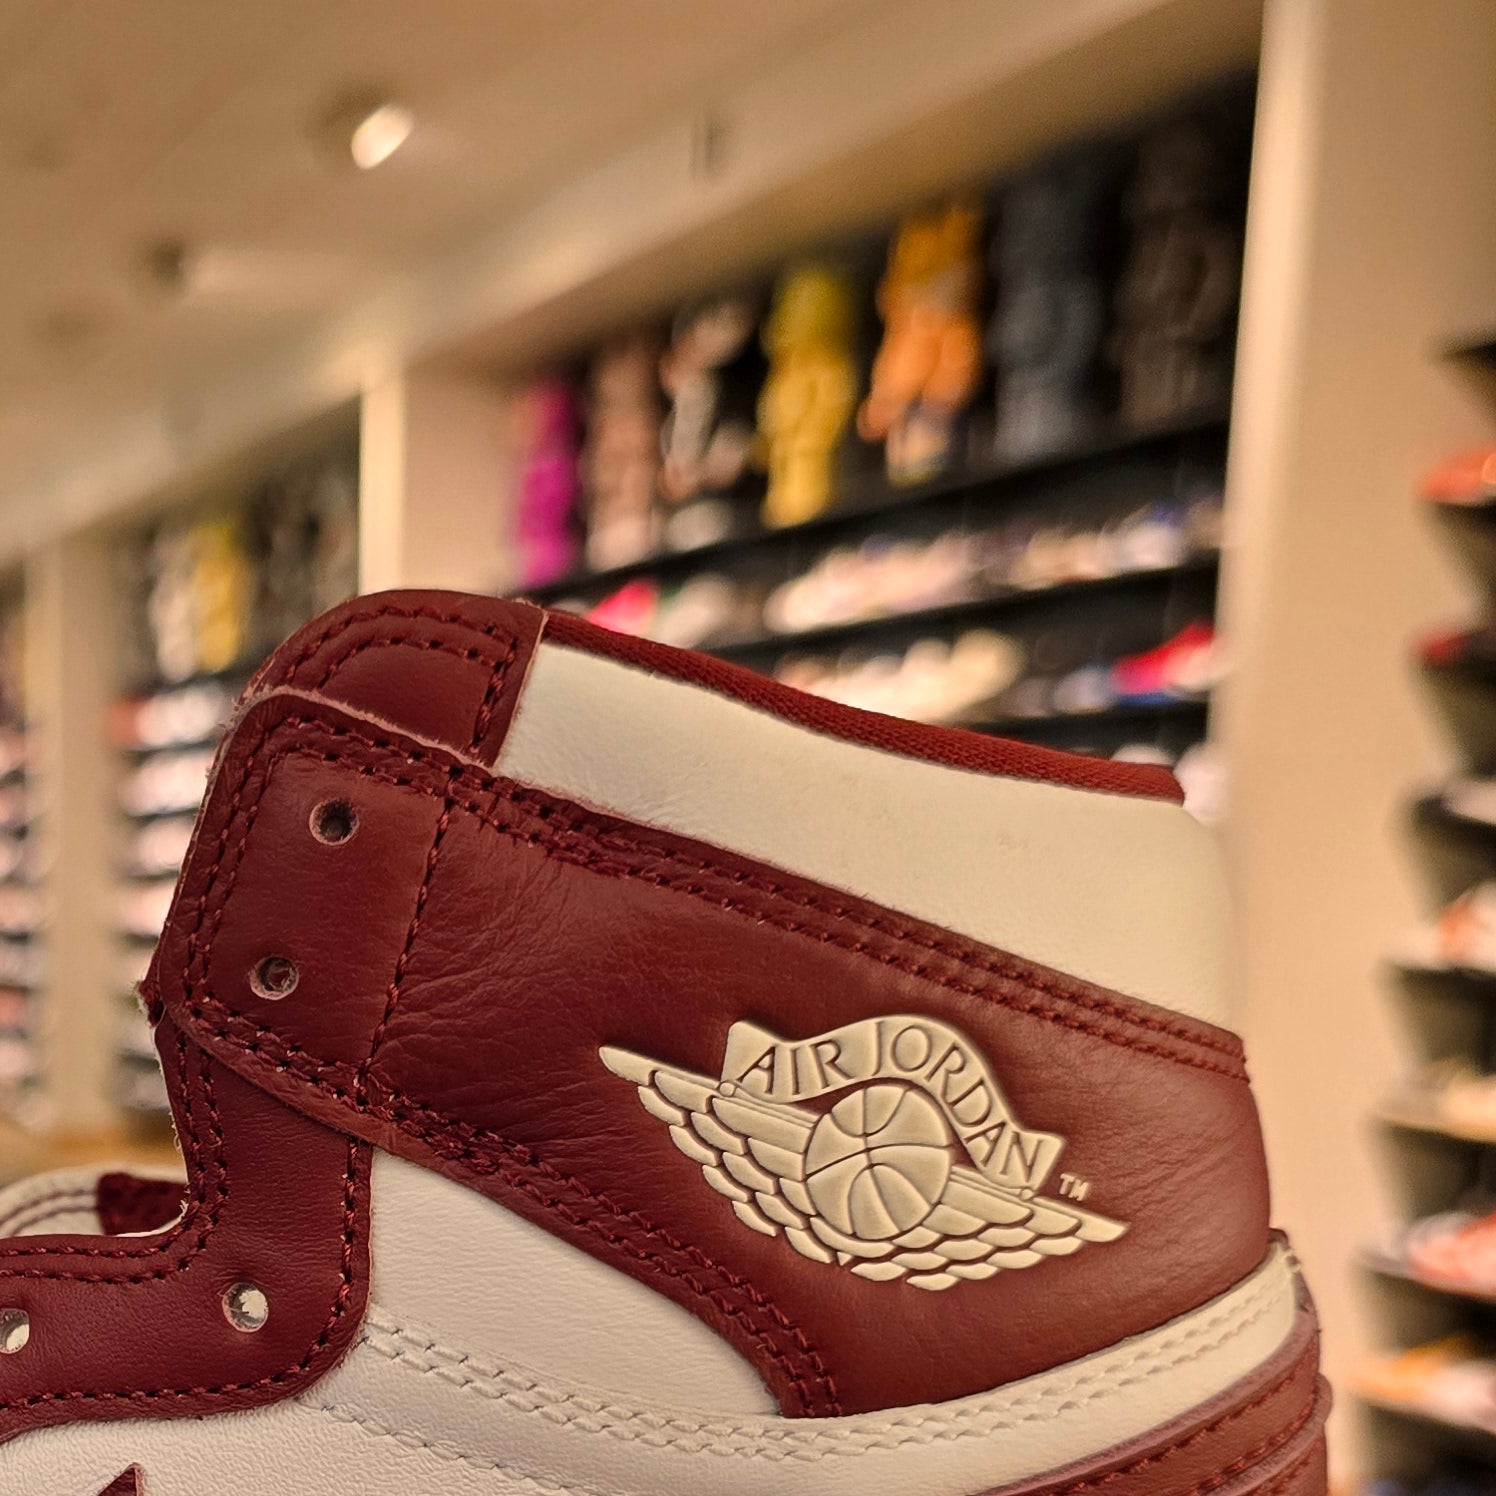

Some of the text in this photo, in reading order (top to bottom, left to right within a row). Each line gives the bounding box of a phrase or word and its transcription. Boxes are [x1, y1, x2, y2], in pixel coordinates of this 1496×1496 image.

[737, 1021, 1044, 1181] AIR JORDAN
[1059, 1173, 1090, 1201] TM
